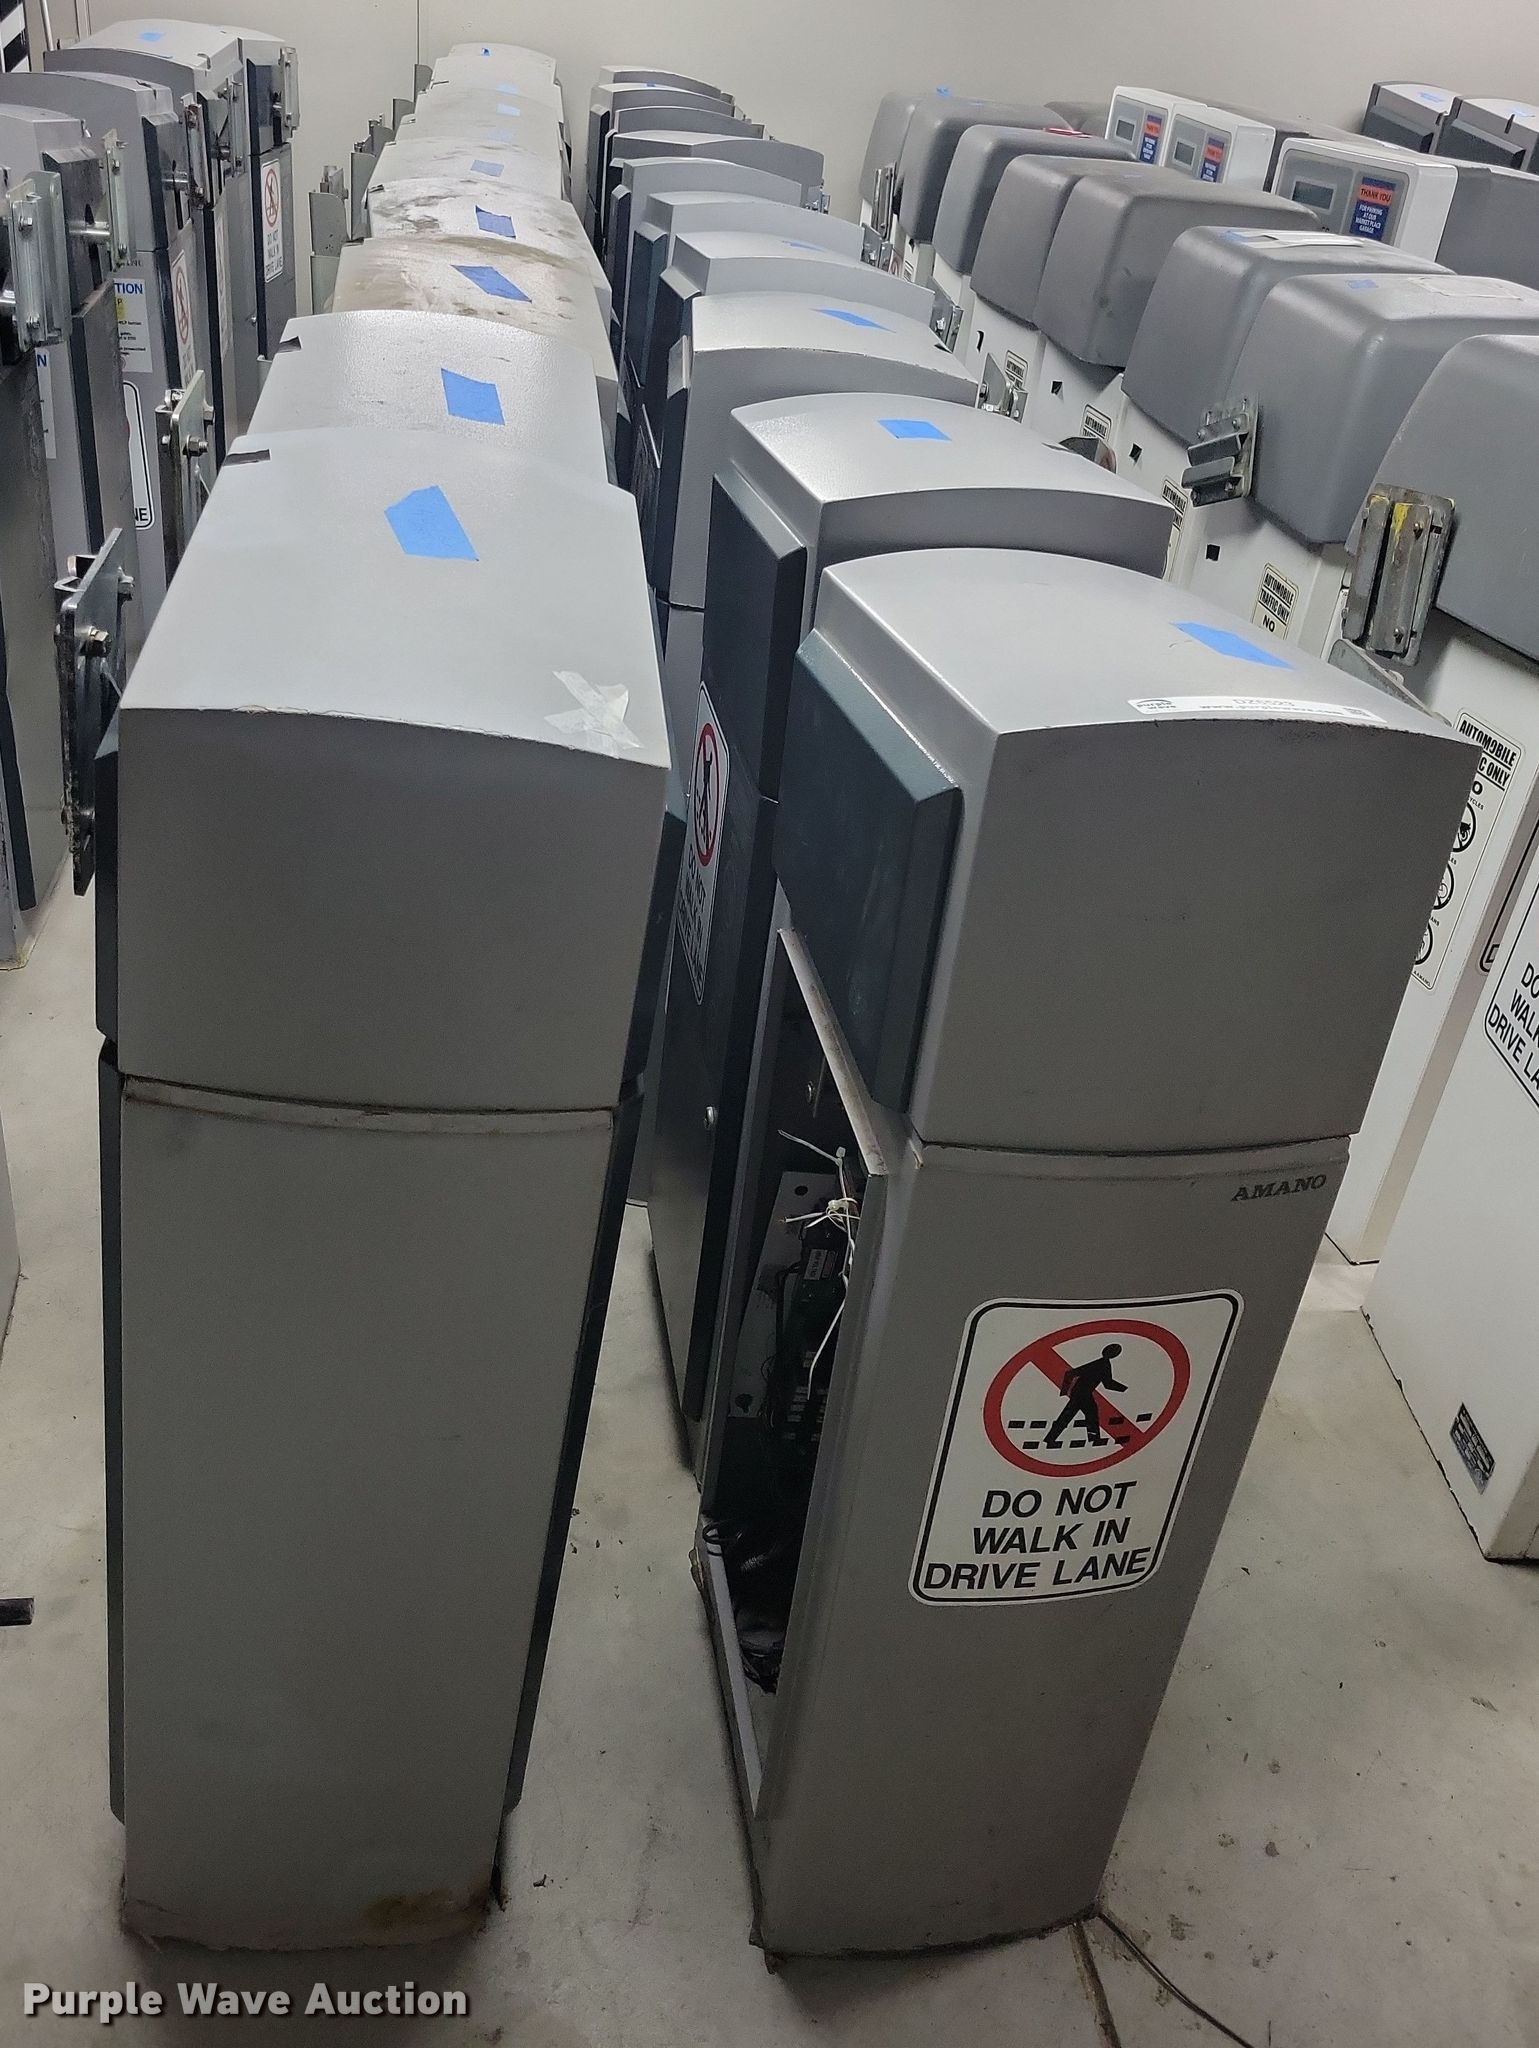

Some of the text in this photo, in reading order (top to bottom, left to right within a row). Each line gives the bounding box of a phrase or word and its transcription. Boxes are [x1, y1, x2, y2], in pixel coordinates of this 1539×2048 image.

[1361, 188, 1392, 202] THANK YOU
[1260, 588, 1290, 623] TRAFFIC ONLY
[1264, 573, 1294, 606] AUTOMOBILE
[1263, 614, 1275, 633] NO
[1459, 720, 1517, 767] AUTOMOBILE
[1486, 762, 1510, 787] ONLY
[1488, 1003, 1526, 1064] DRIVE
[1231, 1174, 1327, 1202] AMANO
[982, 1481, 1137, 1518] DO NOT
[973, 1517, 1131, 1555] WALK IN
[923, 1547, 1151, 1590] DRIVE LANE
